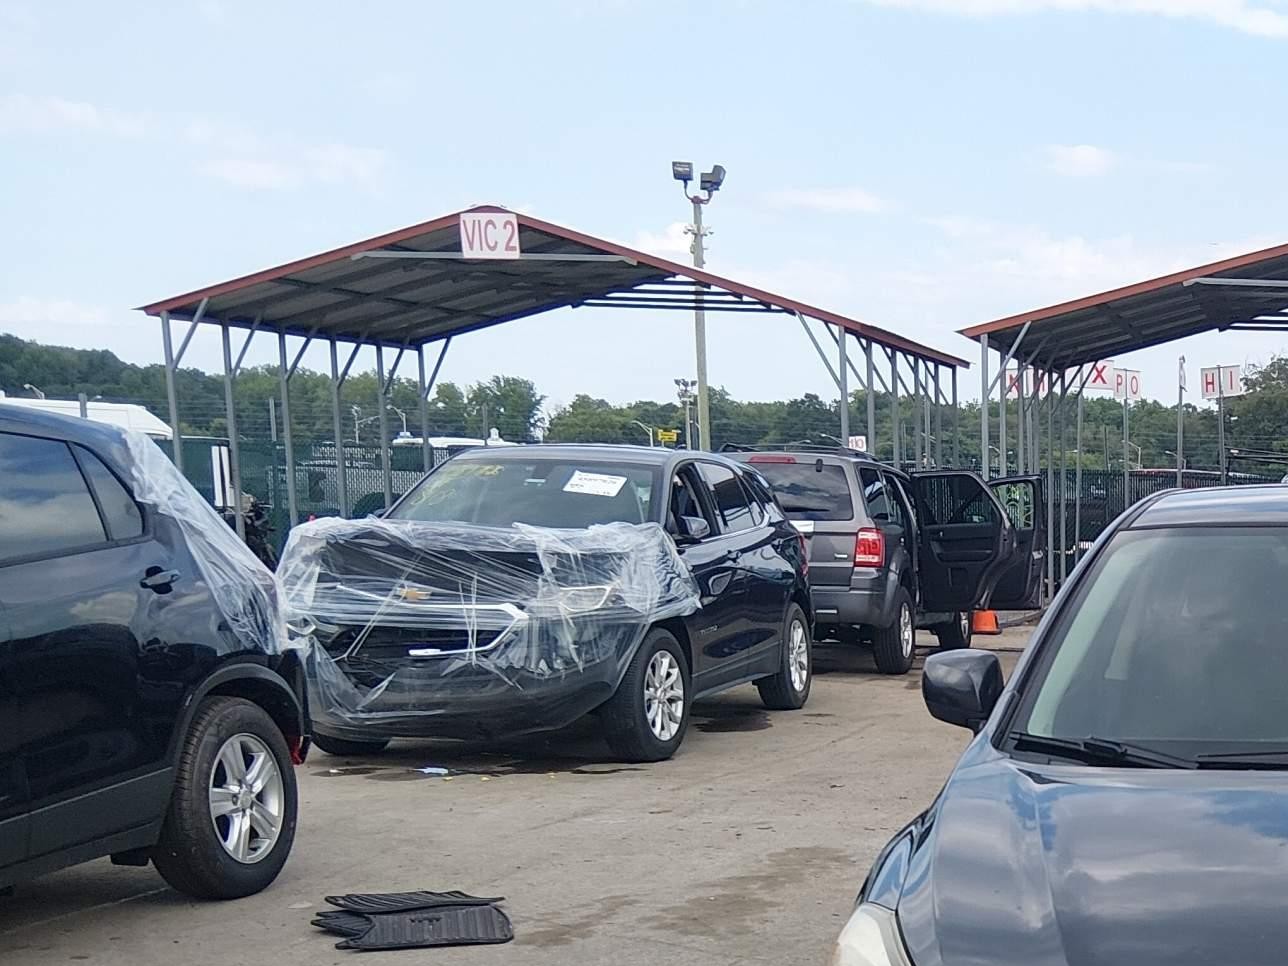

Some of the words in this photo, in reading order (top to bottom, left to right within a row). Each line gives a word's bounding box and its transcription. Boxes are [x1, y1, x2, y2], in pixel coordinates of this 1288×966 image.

[463, 219, 498, 252] VIC
[503, 220, 517, 252] 2
[1092, 365, 1107, 385] X
[1116, 374, 1123, 393] P
[1205, 372, 1215, 393] H
